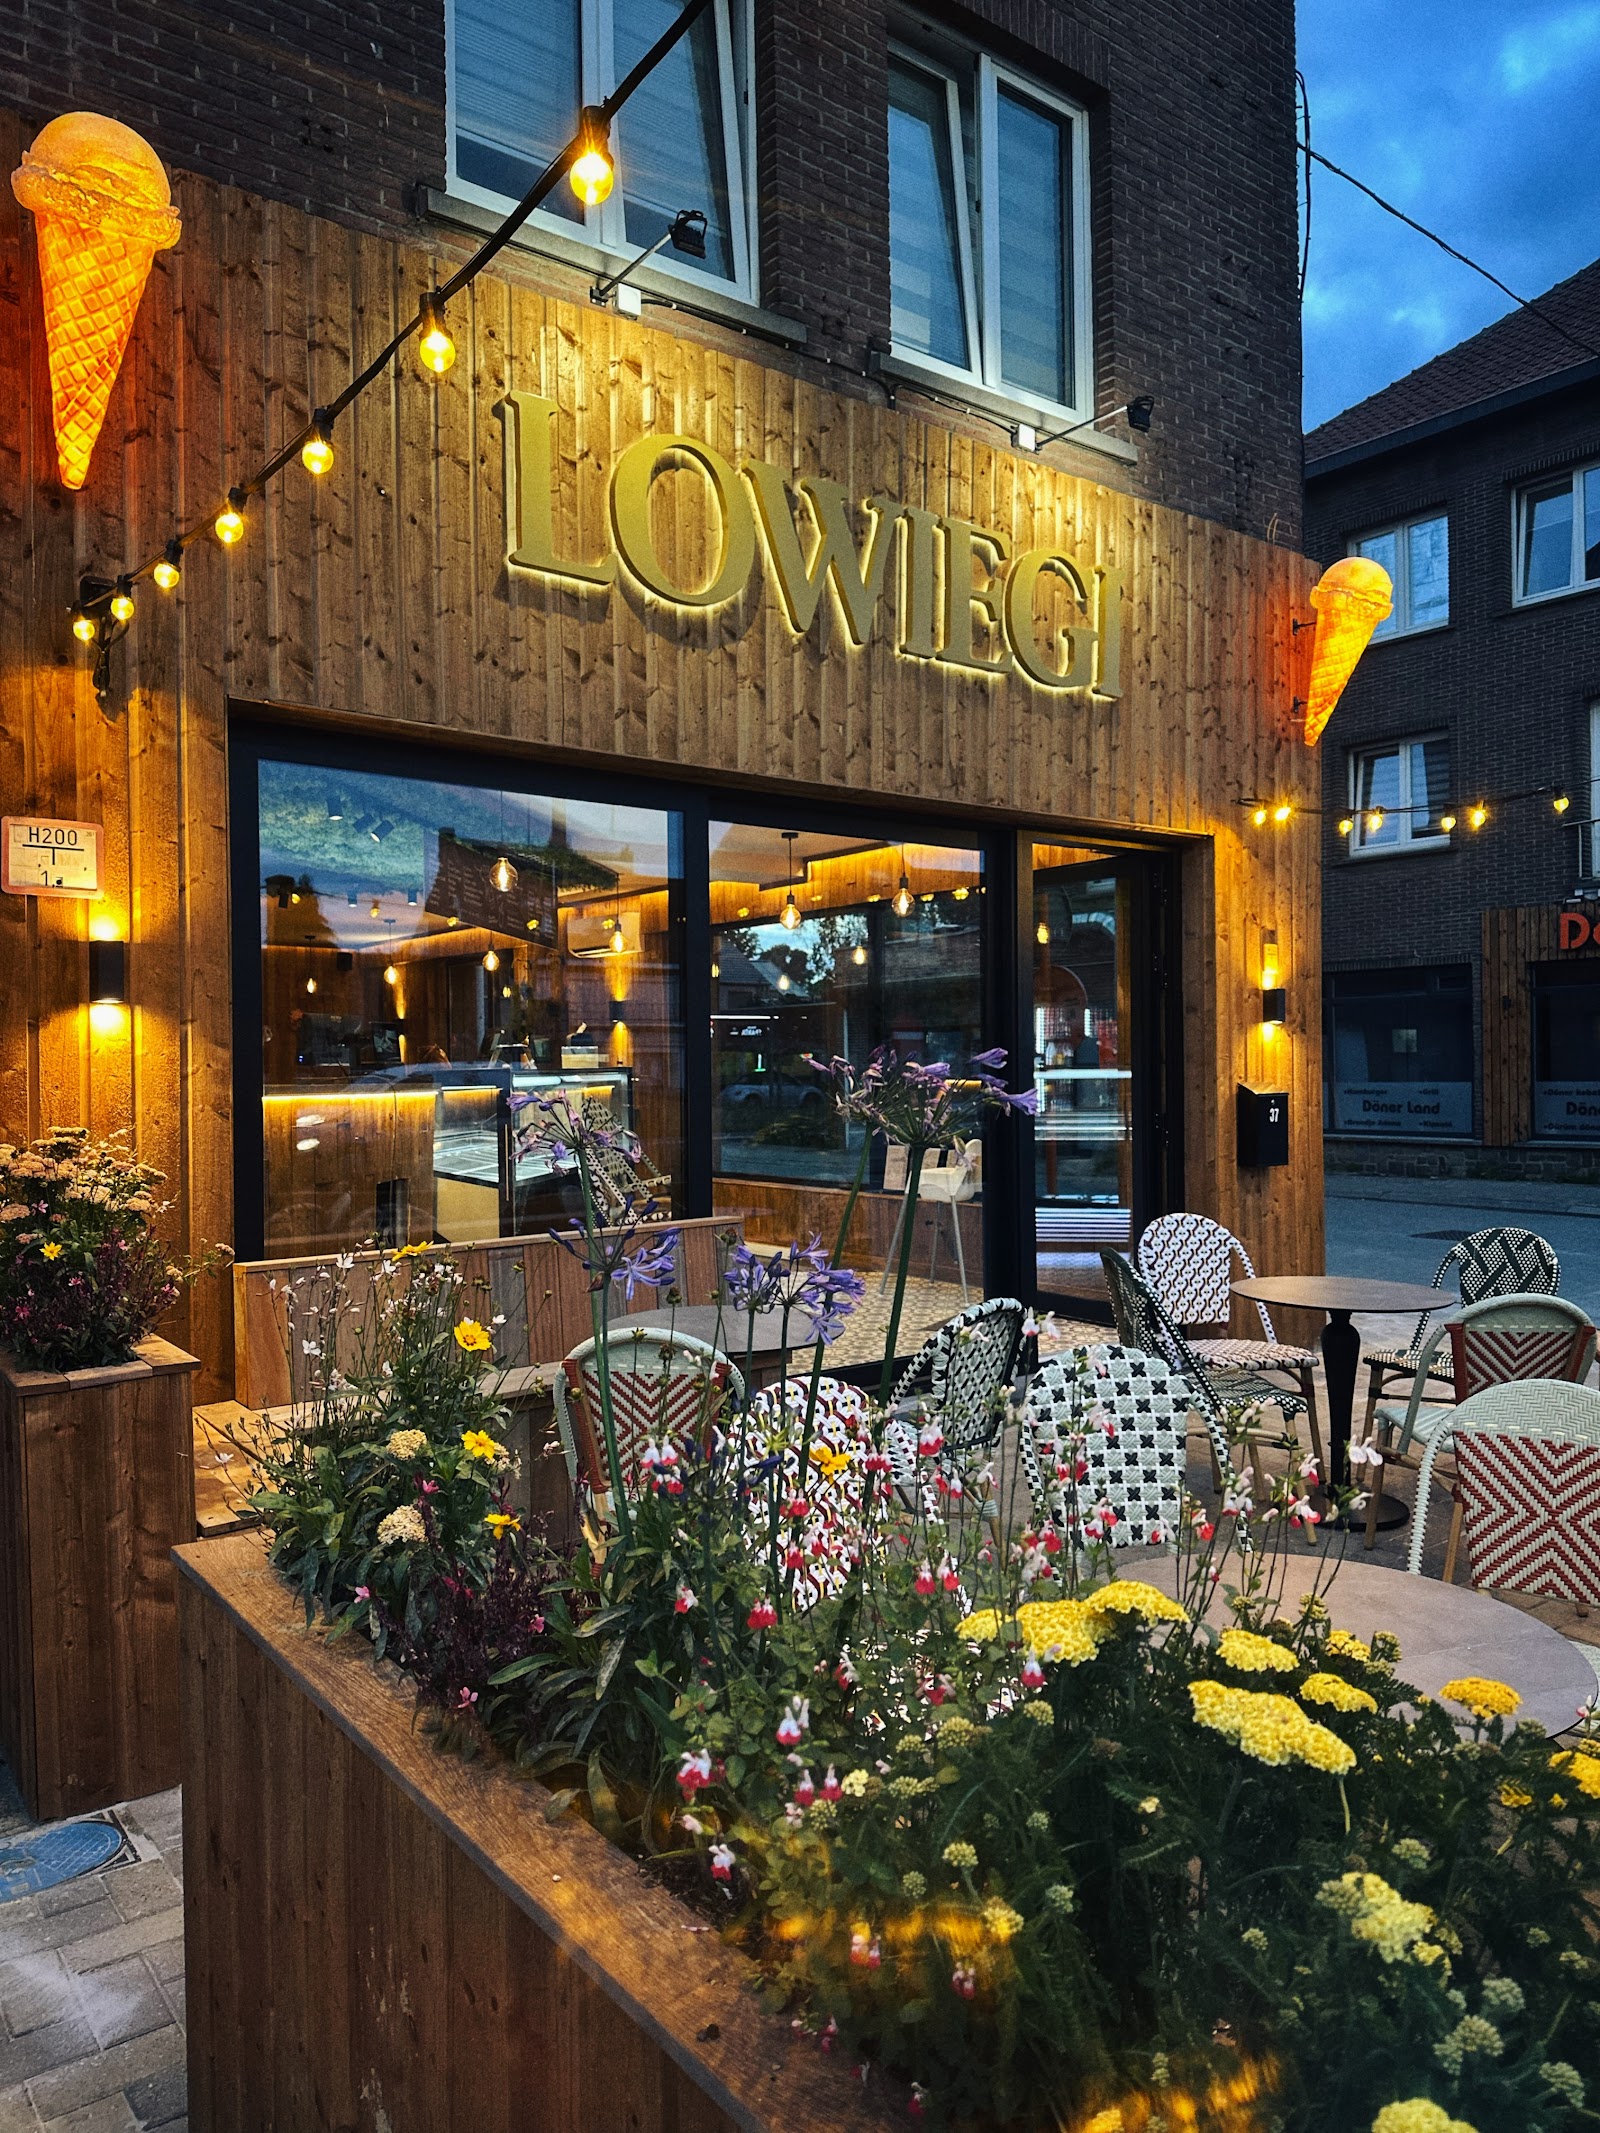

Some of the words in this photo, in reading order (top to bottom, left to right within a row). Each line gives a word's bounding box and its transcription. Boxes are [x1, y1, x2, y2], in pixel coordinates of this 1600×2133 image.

[502, 389, 1124, 699] LOWIEGI
[28, 826, 78, 846] H200
[1559, 912, 1600, 949] D
[1269, 1107, 1280, 1123] 37
[1362, 1099, 1403, 1113] Döner
[1407, 1101, 1440, 1114] Land
[1566, 1101, 1600, 1116] Dön
